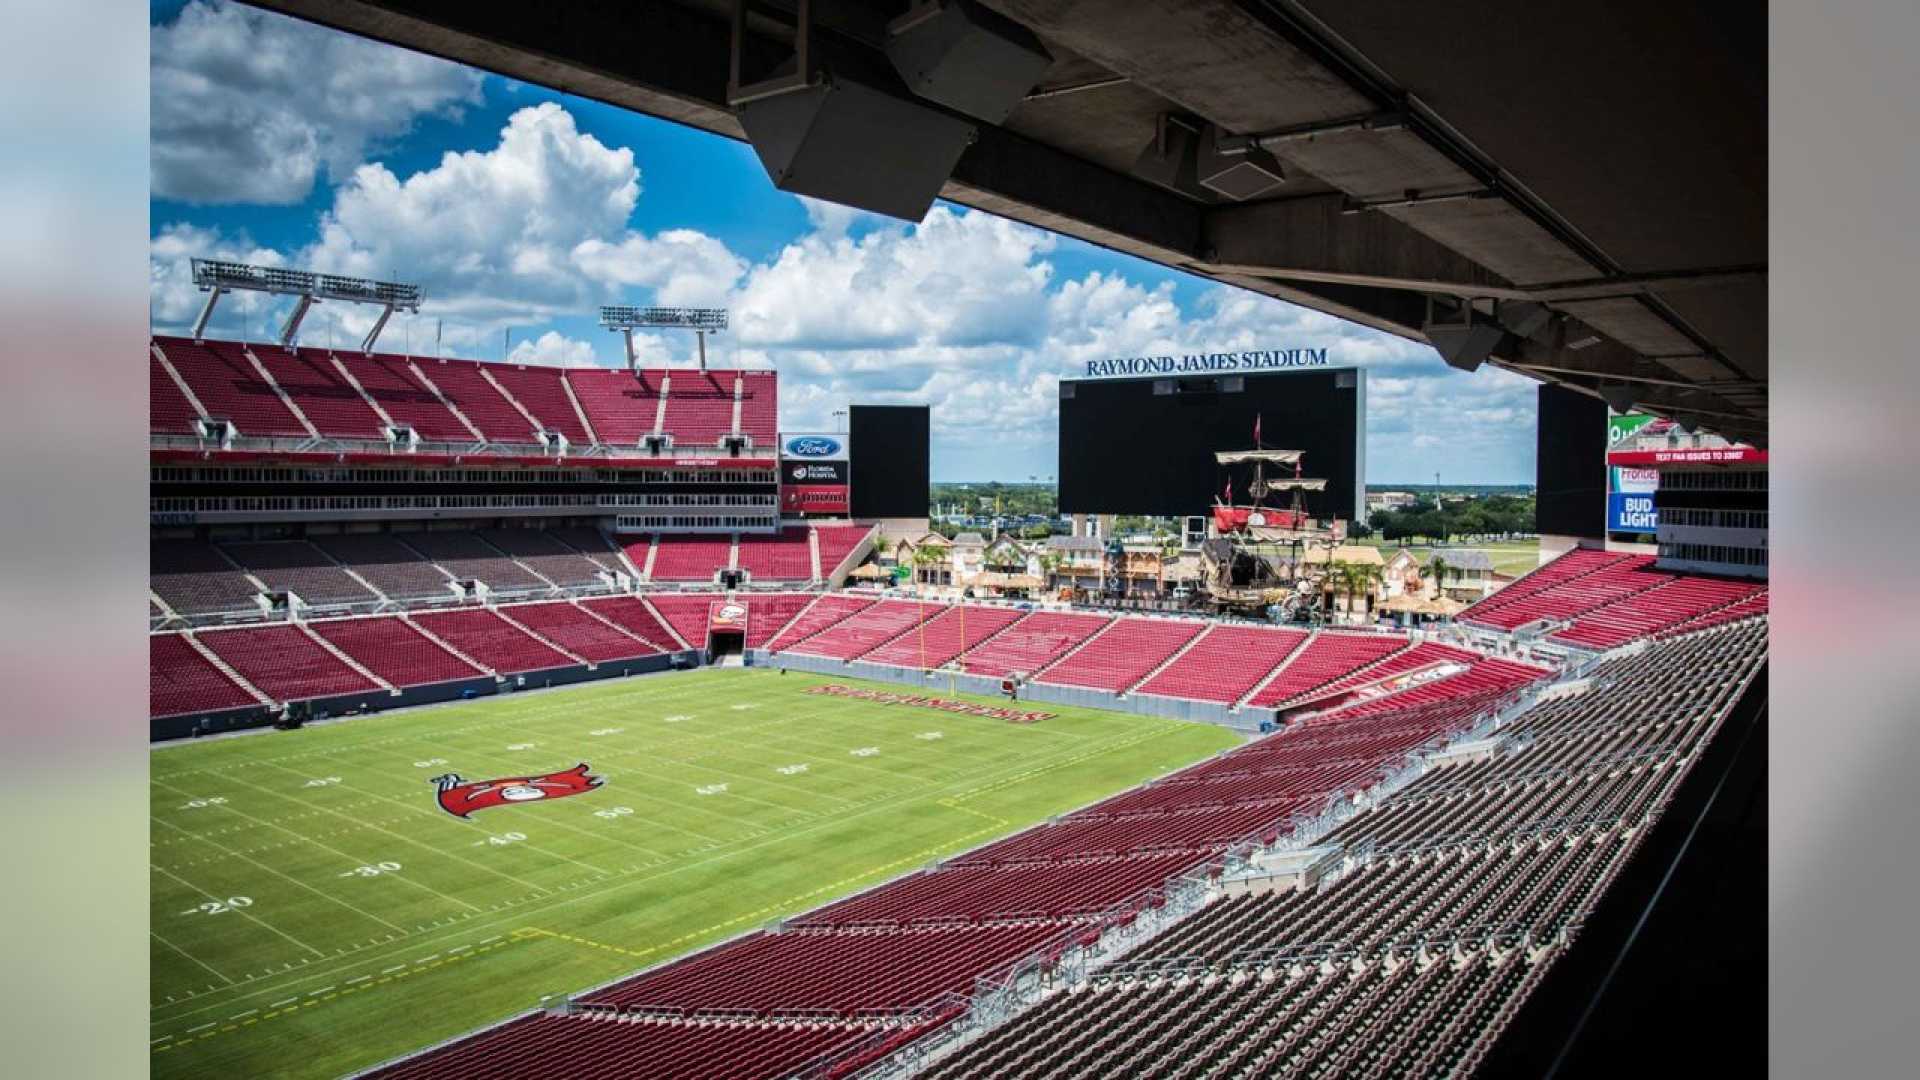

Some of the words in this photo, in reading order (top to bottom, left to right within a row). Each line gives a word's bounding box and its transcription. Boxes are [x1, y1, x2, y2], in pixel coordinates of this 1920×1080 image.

[1087, 356, 1174, 376] RAYMOND
[1177, 353, 1238, 372] JAMES
[1241, 348, 1328, 369] STADIUM
[797, 439, 831, 454] Ford
[1625, 498, 1652, 512] BUD
[1620, 512, 1658, 527] LIGHT
[355, 861, 402, 877] 30
[200, 896, 253, 915] 20
